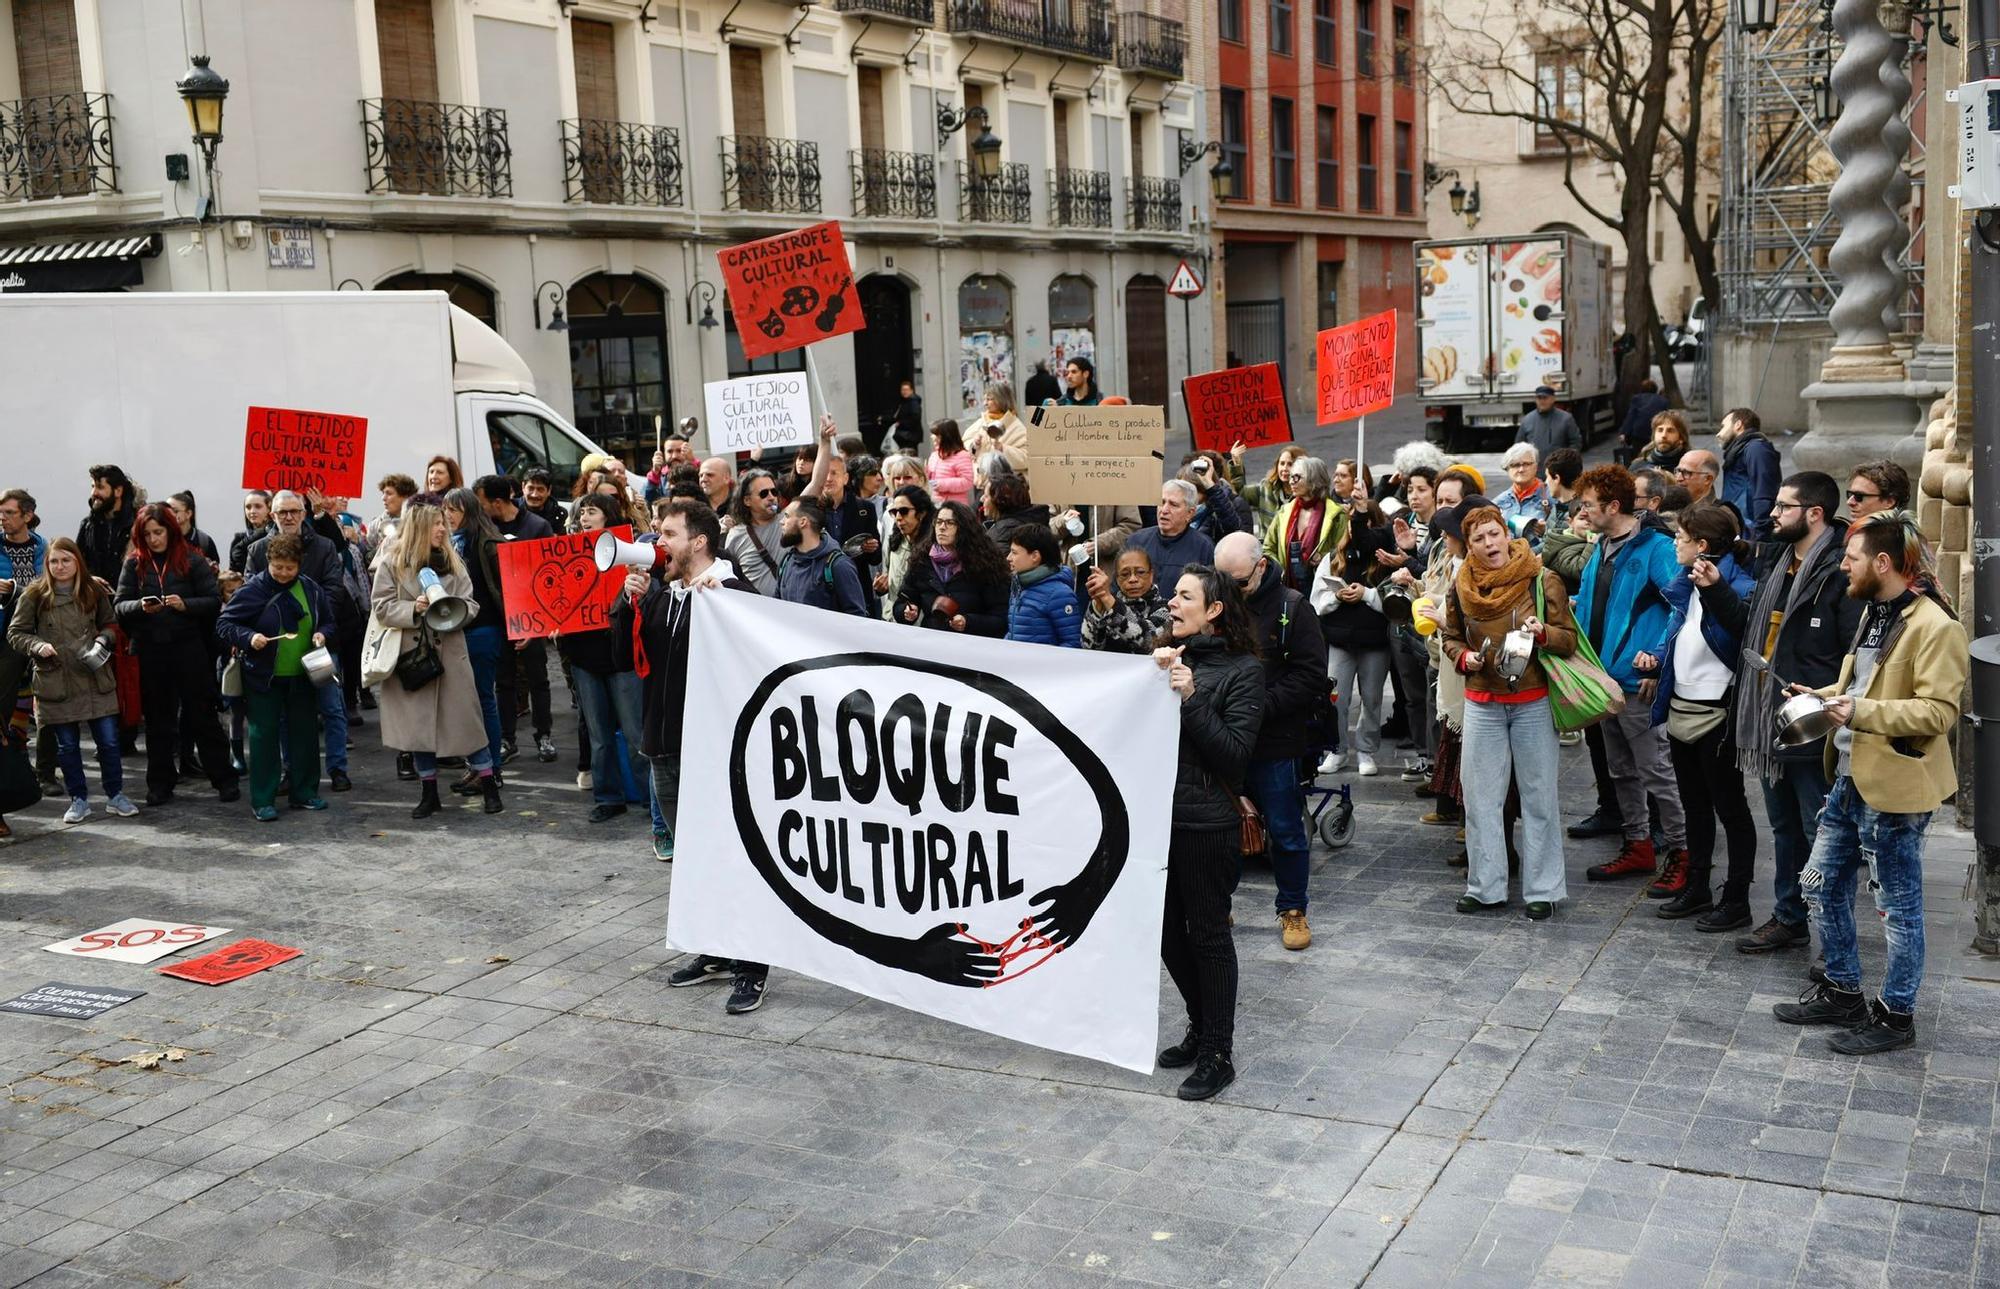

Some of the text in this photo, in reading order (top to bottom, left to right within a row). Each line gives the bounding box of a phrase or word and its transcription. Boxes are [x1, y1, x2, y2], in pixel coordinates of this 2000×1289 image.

[283, 228, 310, 241] CALLE
[727, 228, 831, 267] CATASTROFE
[742, 248, 832, 284] CULTURAL
[1324, 321, 1390, 357] MOVIMIENTO
[1336, 345, 1380, 370] VECINAL
[1200, 369, 1264, 397] GESTIÓN
[1321, 355, 1393, 393] QUE DEFIENDE
[722, 380, 800, 401] EL TEJIDO
[1202, 388, 1268, 414] CULTURAL
[1324, 379, 1392, 416] EL CULTURAL
[723, 398, 789, 418] CULTURAL
[266, 411, 355, 439] EL TEJIDO
[725, 412, 793, 431] VITAMINA
[1043, 413, 1161, 431] La Cultura es producto
[1204, 416, 1222, 432] DE
[250, 431, 354, 458] CULTURAL ES
[727, 427, 797, 447] LA CIUDAD
[1055, 430, 1143, 442] del Hombre Libre
[1212, 427, 1272, 449] Y LOCAL
[273, 451, 348, 473] SALUD EN LA
[1044, 458, 1055, 466] En
[1060, 454, 1074, 466] ella
[1081, 459, 1090, 467] se
[264, 469, 326, 493] CIUDAD
[1071, 471, 1127, 486] y reconoce
[541, 536, 595, 559] HOLA
[509, 611, 545, 634] NOS
[770, 688, 1020, 816] BLOQUE
[778, 809, 1024, 915] CULTURAL
